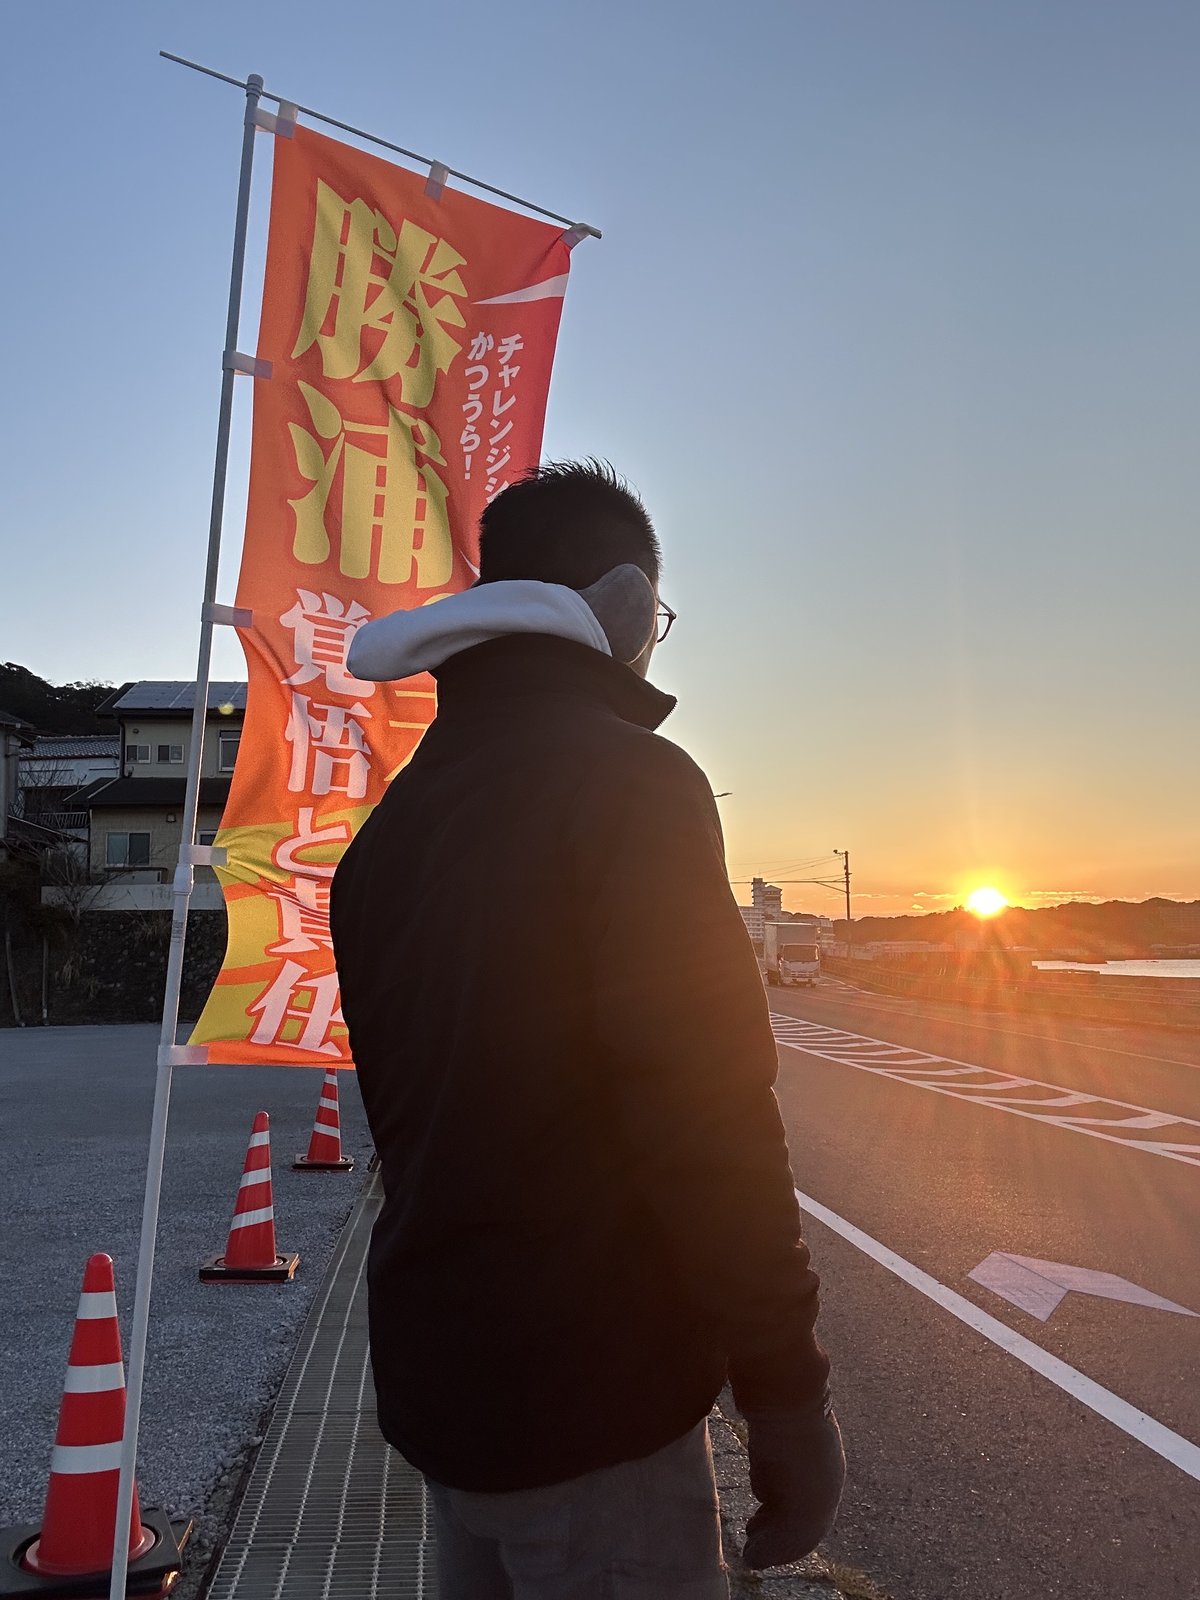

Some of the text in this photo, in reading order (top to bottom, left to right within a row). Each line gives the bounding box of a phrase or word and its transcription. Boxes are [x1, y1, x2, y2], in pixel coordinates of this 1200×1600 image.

[287, 177, 467, 588] 勝浦
[459, 331, 494, 479] かつうら!
